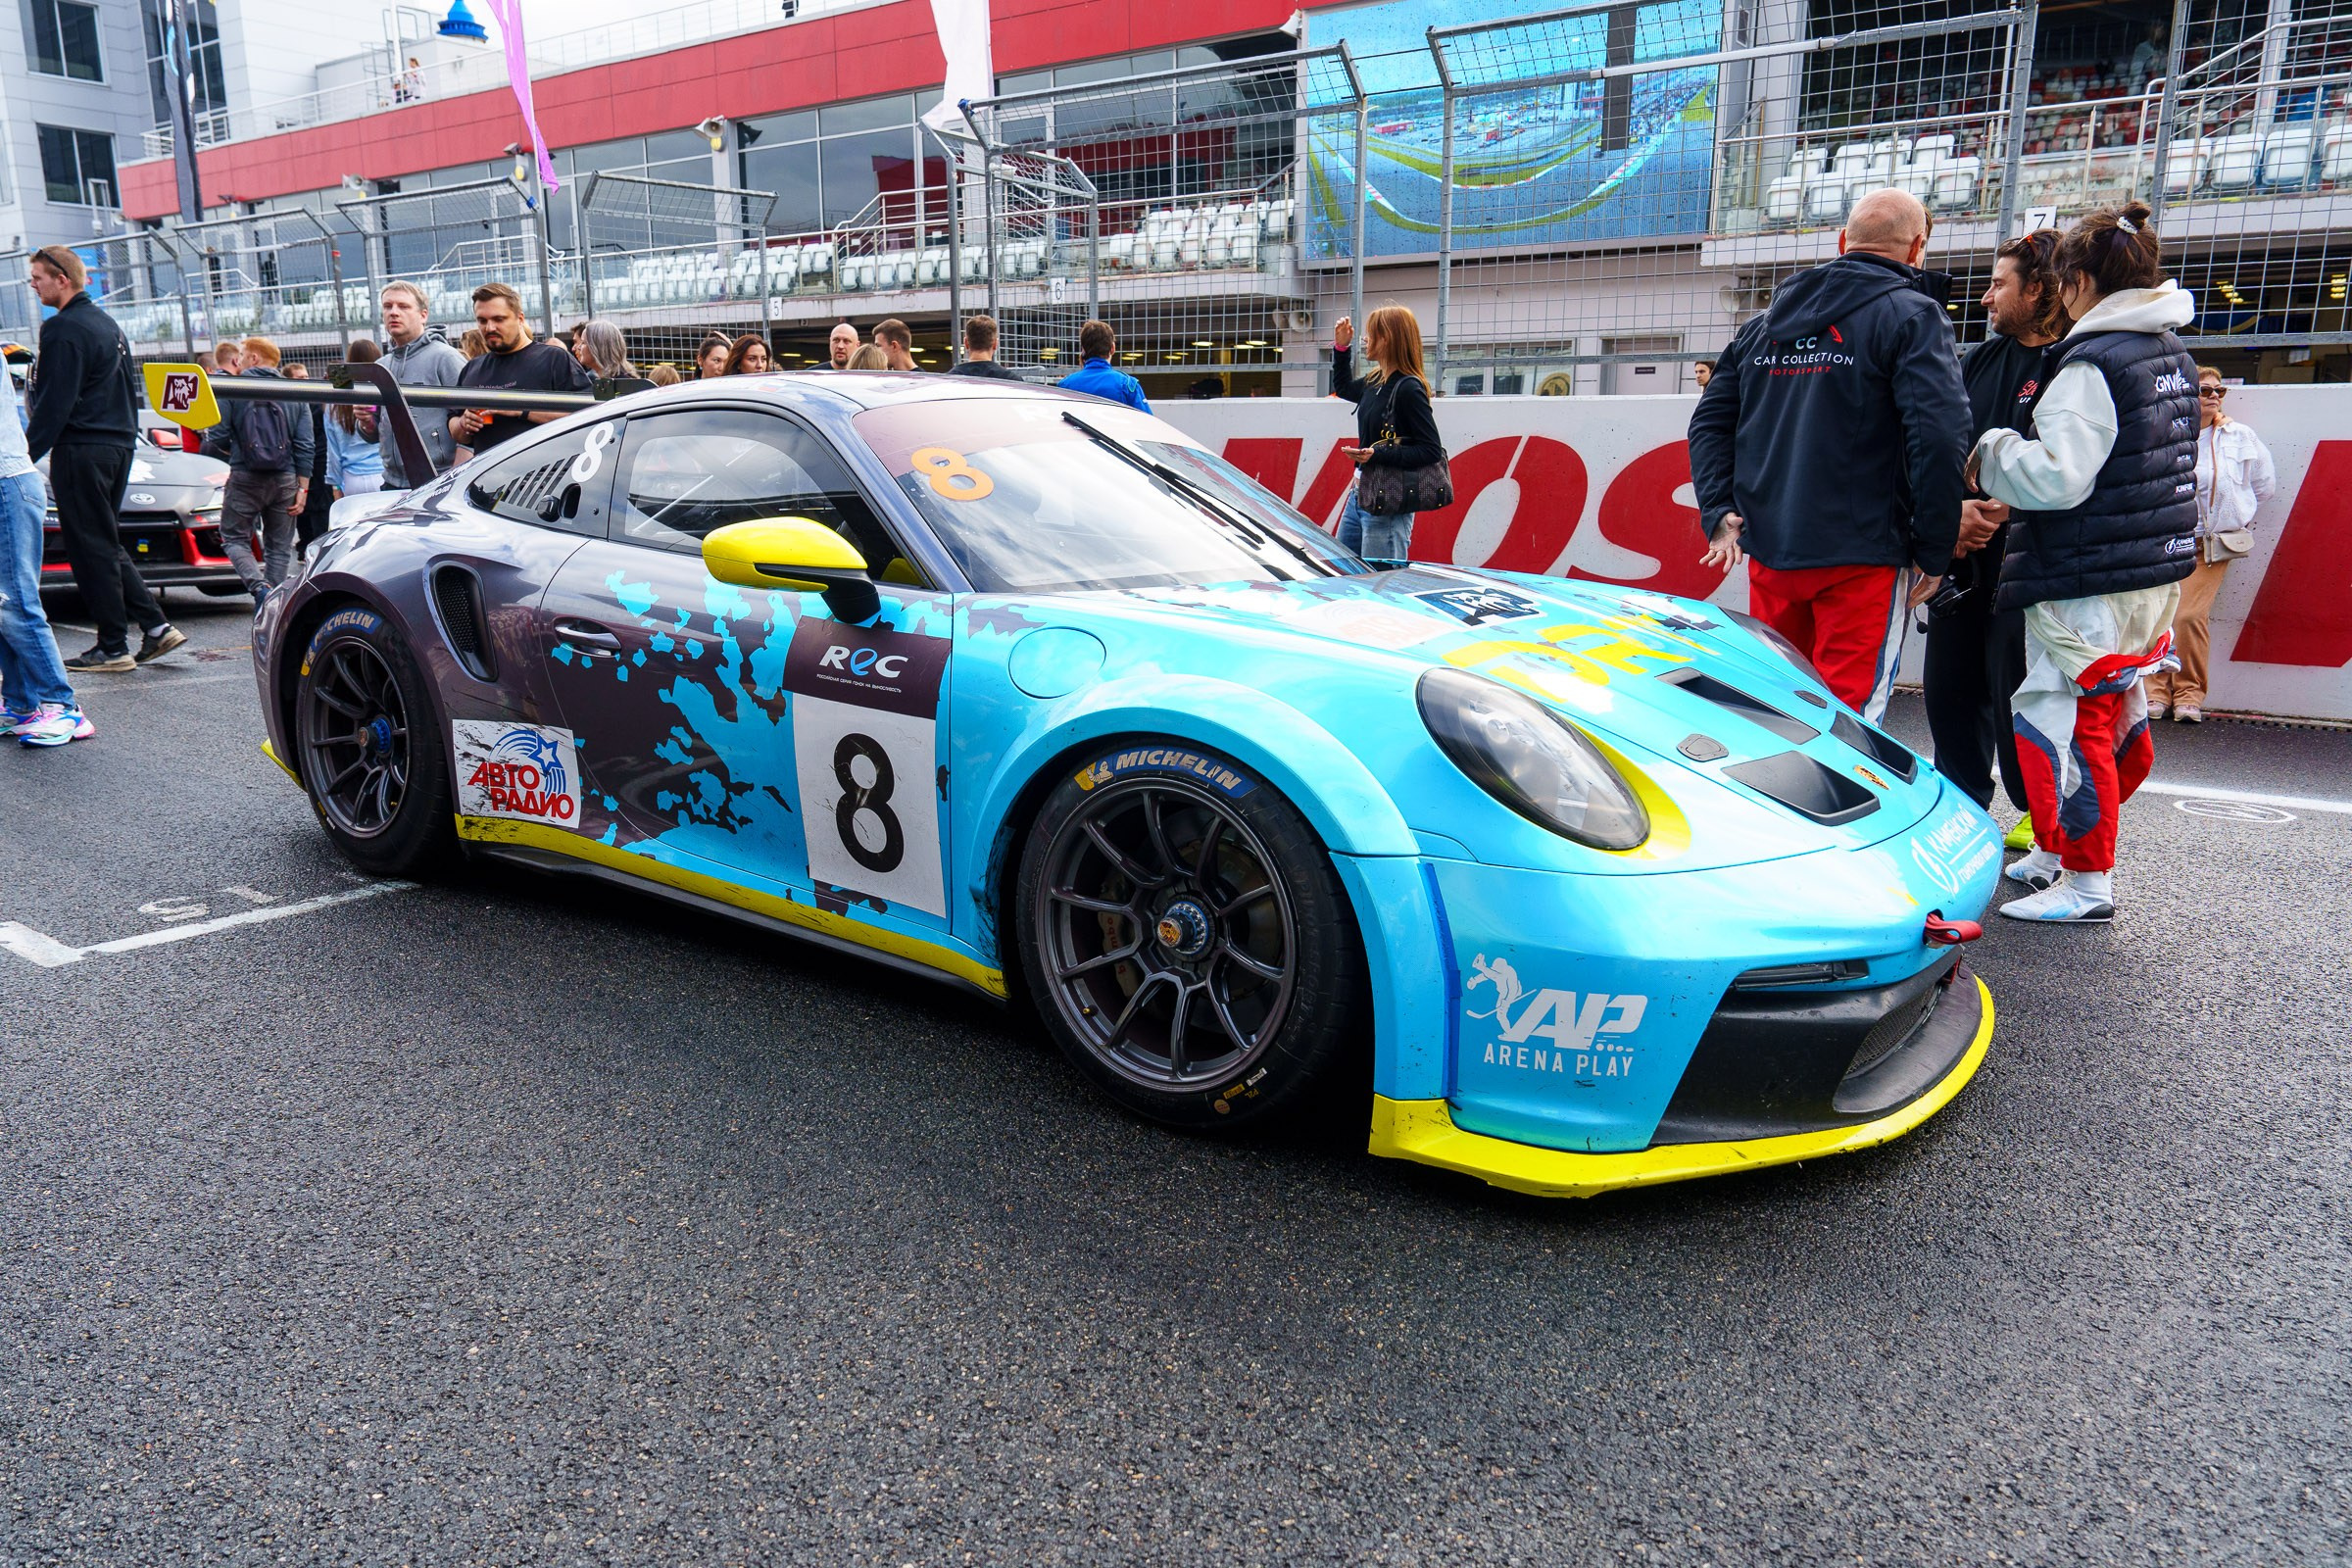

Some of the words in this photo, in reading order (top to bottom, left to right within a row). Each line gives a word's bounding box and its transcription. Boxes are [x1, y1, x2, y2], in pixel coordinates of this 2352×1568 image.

[2034, 213, 2046, 228] 7
[1054, 281, 1062, 300] 6
[773, 300, 780, 317] 5
[1795, 336, 1818, 350] CC
[1753, 356, 1776, 366] CAR
[1782, 352, 1854, 366] COLLECTION
[570, 420, 615, 483] 8
[910, 447, 995, 502] 8
[466, 761, 540, 790] АВТО
[1115, 750, 1243, 791] MICHELIN
[490, 787, 574, 820] РАДИО
[834, 733, 905, 872] 8
[1484, 1042, 1564, 1073] ARENA
[1576, 1054, 1634, 1077] PLAY
